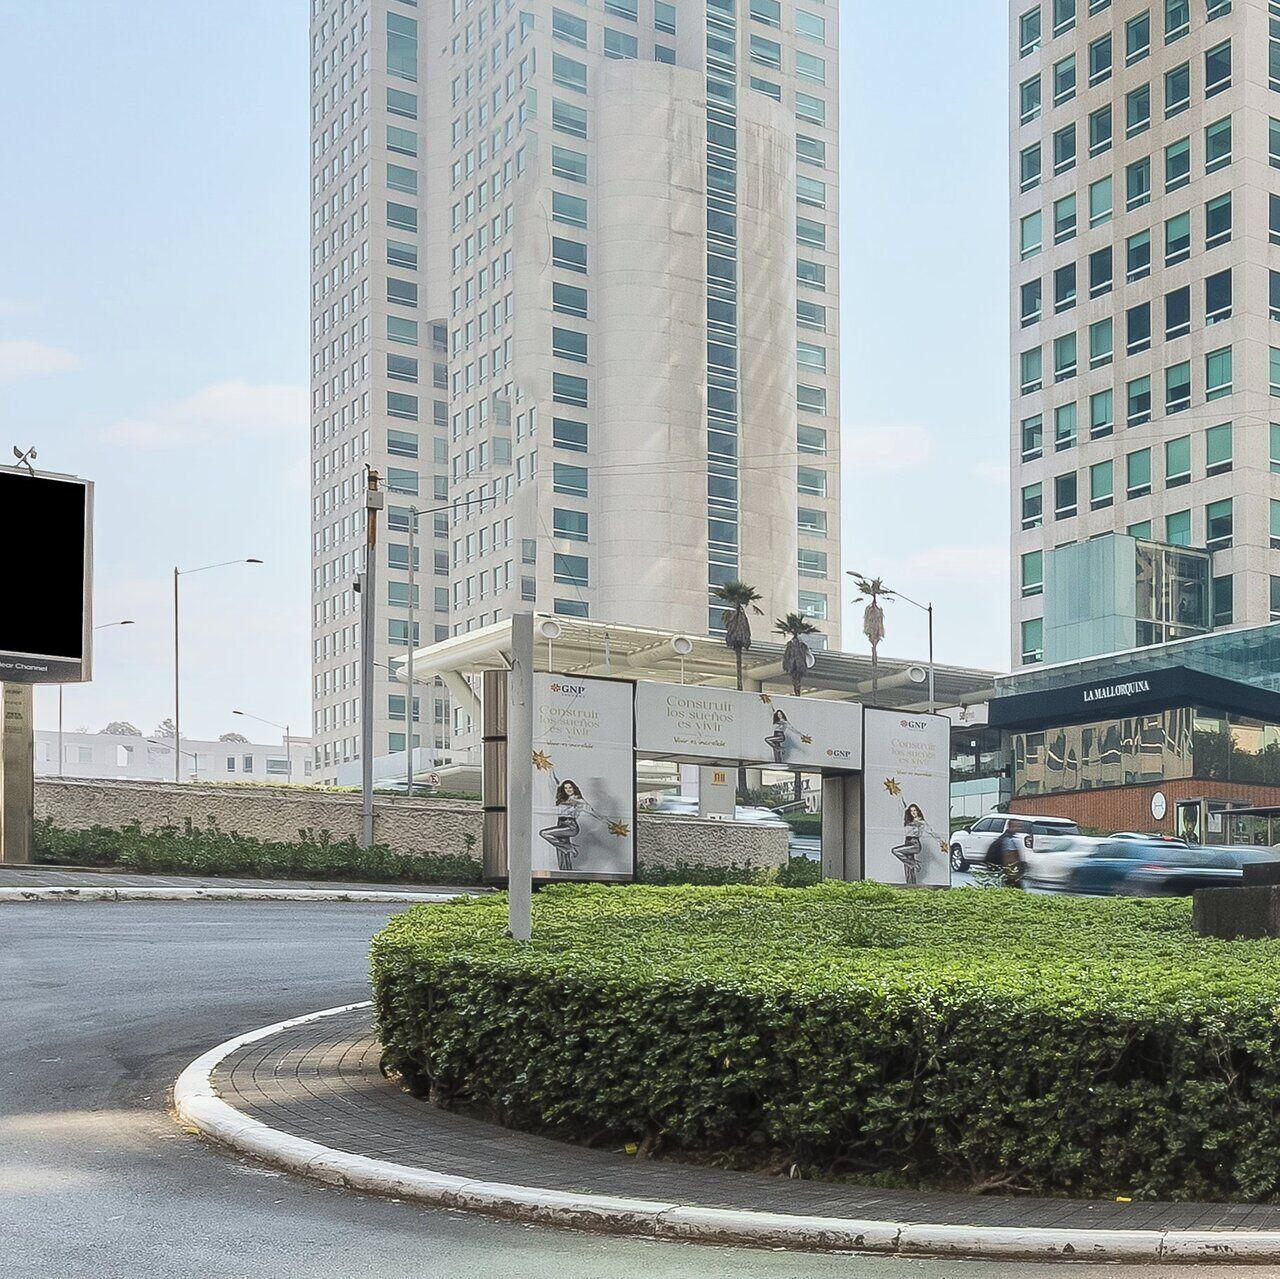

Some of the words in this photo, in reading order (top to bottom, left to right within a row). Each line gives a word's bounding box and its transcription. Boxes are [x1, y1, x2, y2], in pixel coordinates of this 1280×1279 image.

[0, 661, 14, 669] lear
[15, 663, 48, 672] Channel
[561, 684, 585, 694] GNP
[1084, 690, 1094, 701] LA
[1095, 680, 1150, 700] MALLORQUINA
[667, 695, 734, 712] Construir
[667, 707, 685, 719] los
[677, 720, 691, 729] es
[695, 721, 723, 732] vivir
[908, 721, 927, 729] GNP
[833, 749, 850, 757] GNP
